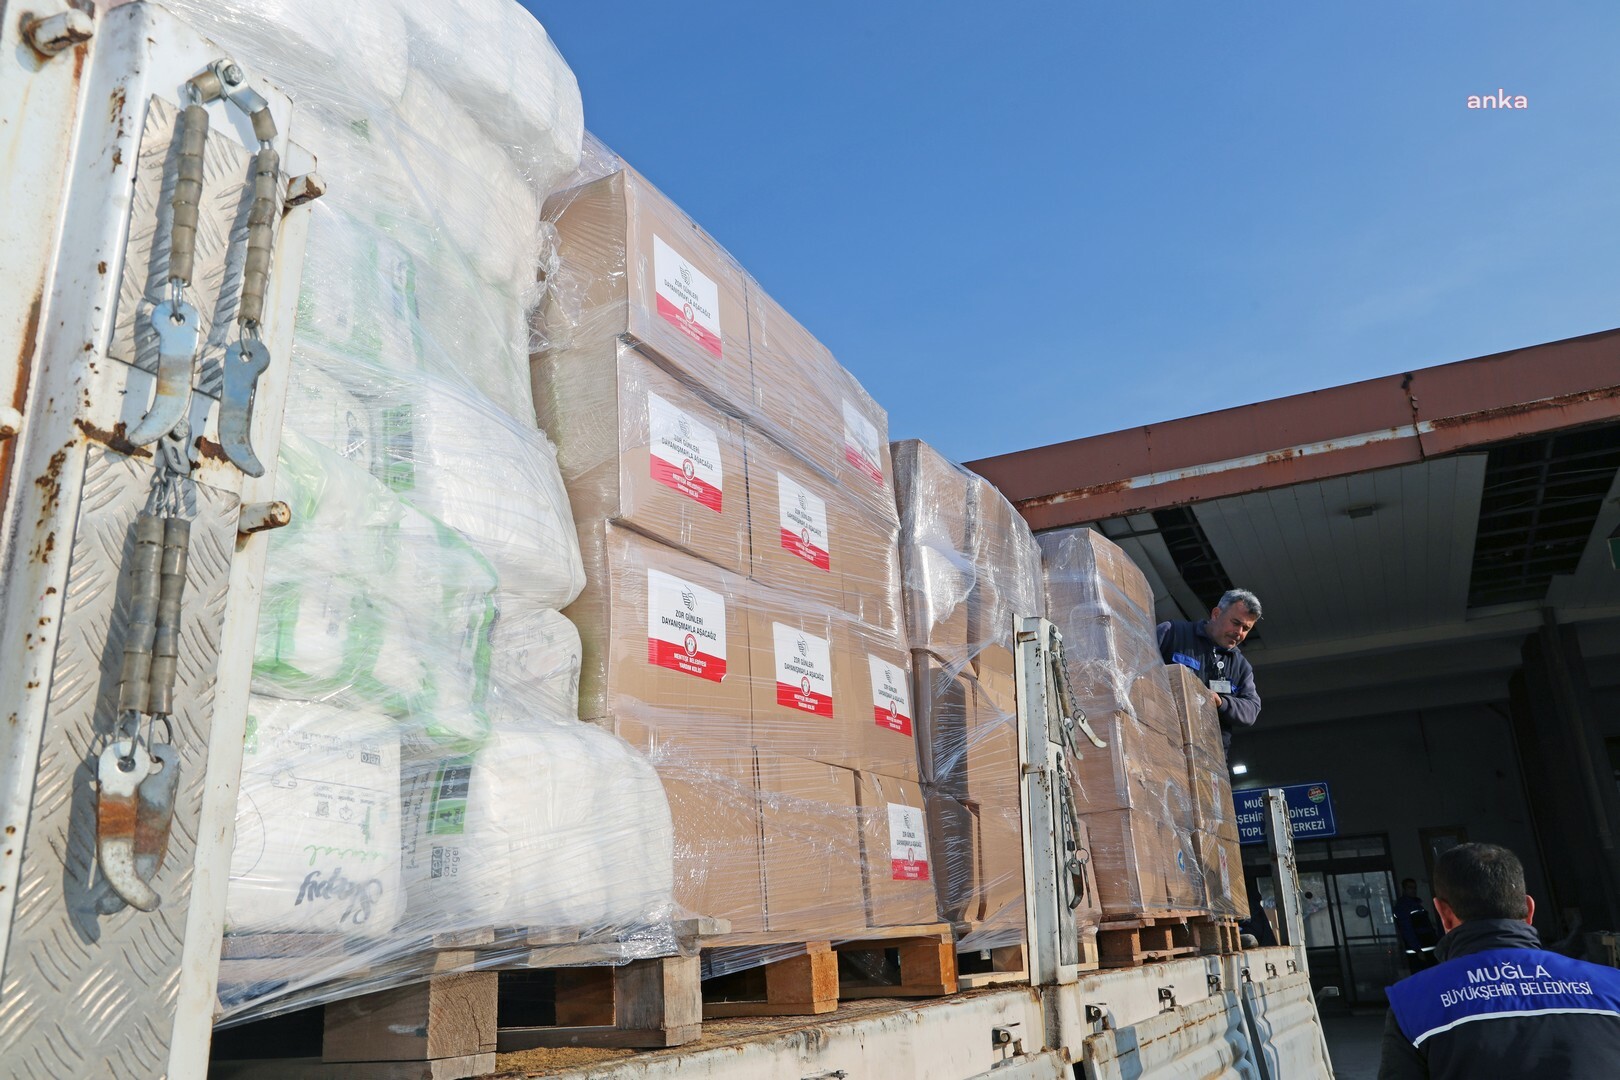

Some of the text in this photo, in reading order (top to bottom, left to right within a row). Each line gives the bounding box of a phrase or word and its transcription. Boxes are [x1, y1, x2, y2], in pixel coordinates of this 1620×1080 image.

[675, 609, 704, 626] ZOR GÜNLERİ
[661, 616, 717, 641] DAYANIŞMAYLA AŞACAĞIZ
[1243, 796, 1264, 809] MUĞ
[440, 811, 453, 820] 4
[1236, 804, 1319, 825] ŞEHİR DİYESİ
[1241, 818, 1326, 838] TOPL ERKEZİ
[432, 846, 443, 878] zero
[1466, 961, 1552, 984] MUĞLA
[1440, 979, 1594, 1008] BÜYÜKŞEHİR BELEDİYESİ
